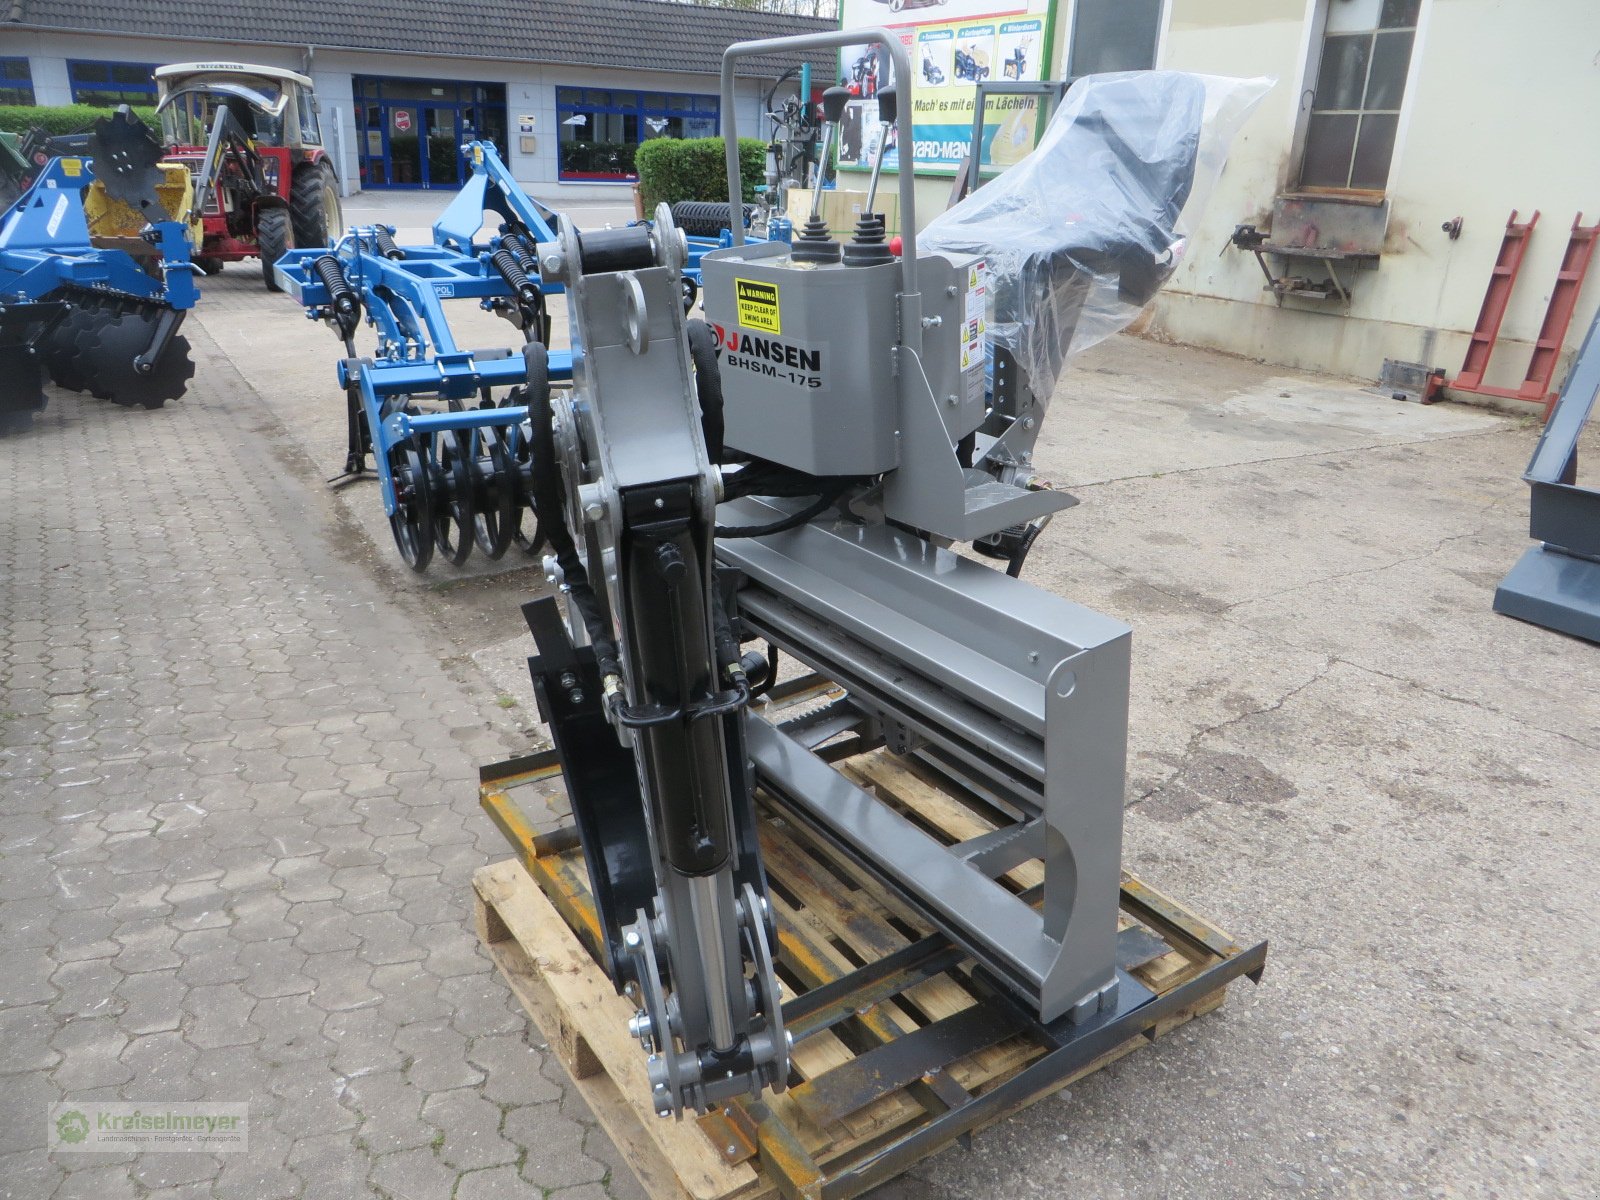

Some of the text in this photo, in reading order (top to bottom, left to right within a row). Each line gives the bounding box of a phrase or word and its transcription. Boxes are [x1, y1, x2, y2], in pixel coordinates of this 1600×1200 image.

[939, 102, 949, 111] es
[950, 98, 965, 110] mit
[966, 99, 994, 111] eim
[746, 289, 775, 301] WARNING
[741, 302, 776, 316] KEEP CLEAR OF
[744, 313, 773, 325] SWING AREA
[727, 332, 820, 372] JANSEN
[728, 355, 822, 388] BHSM-175
